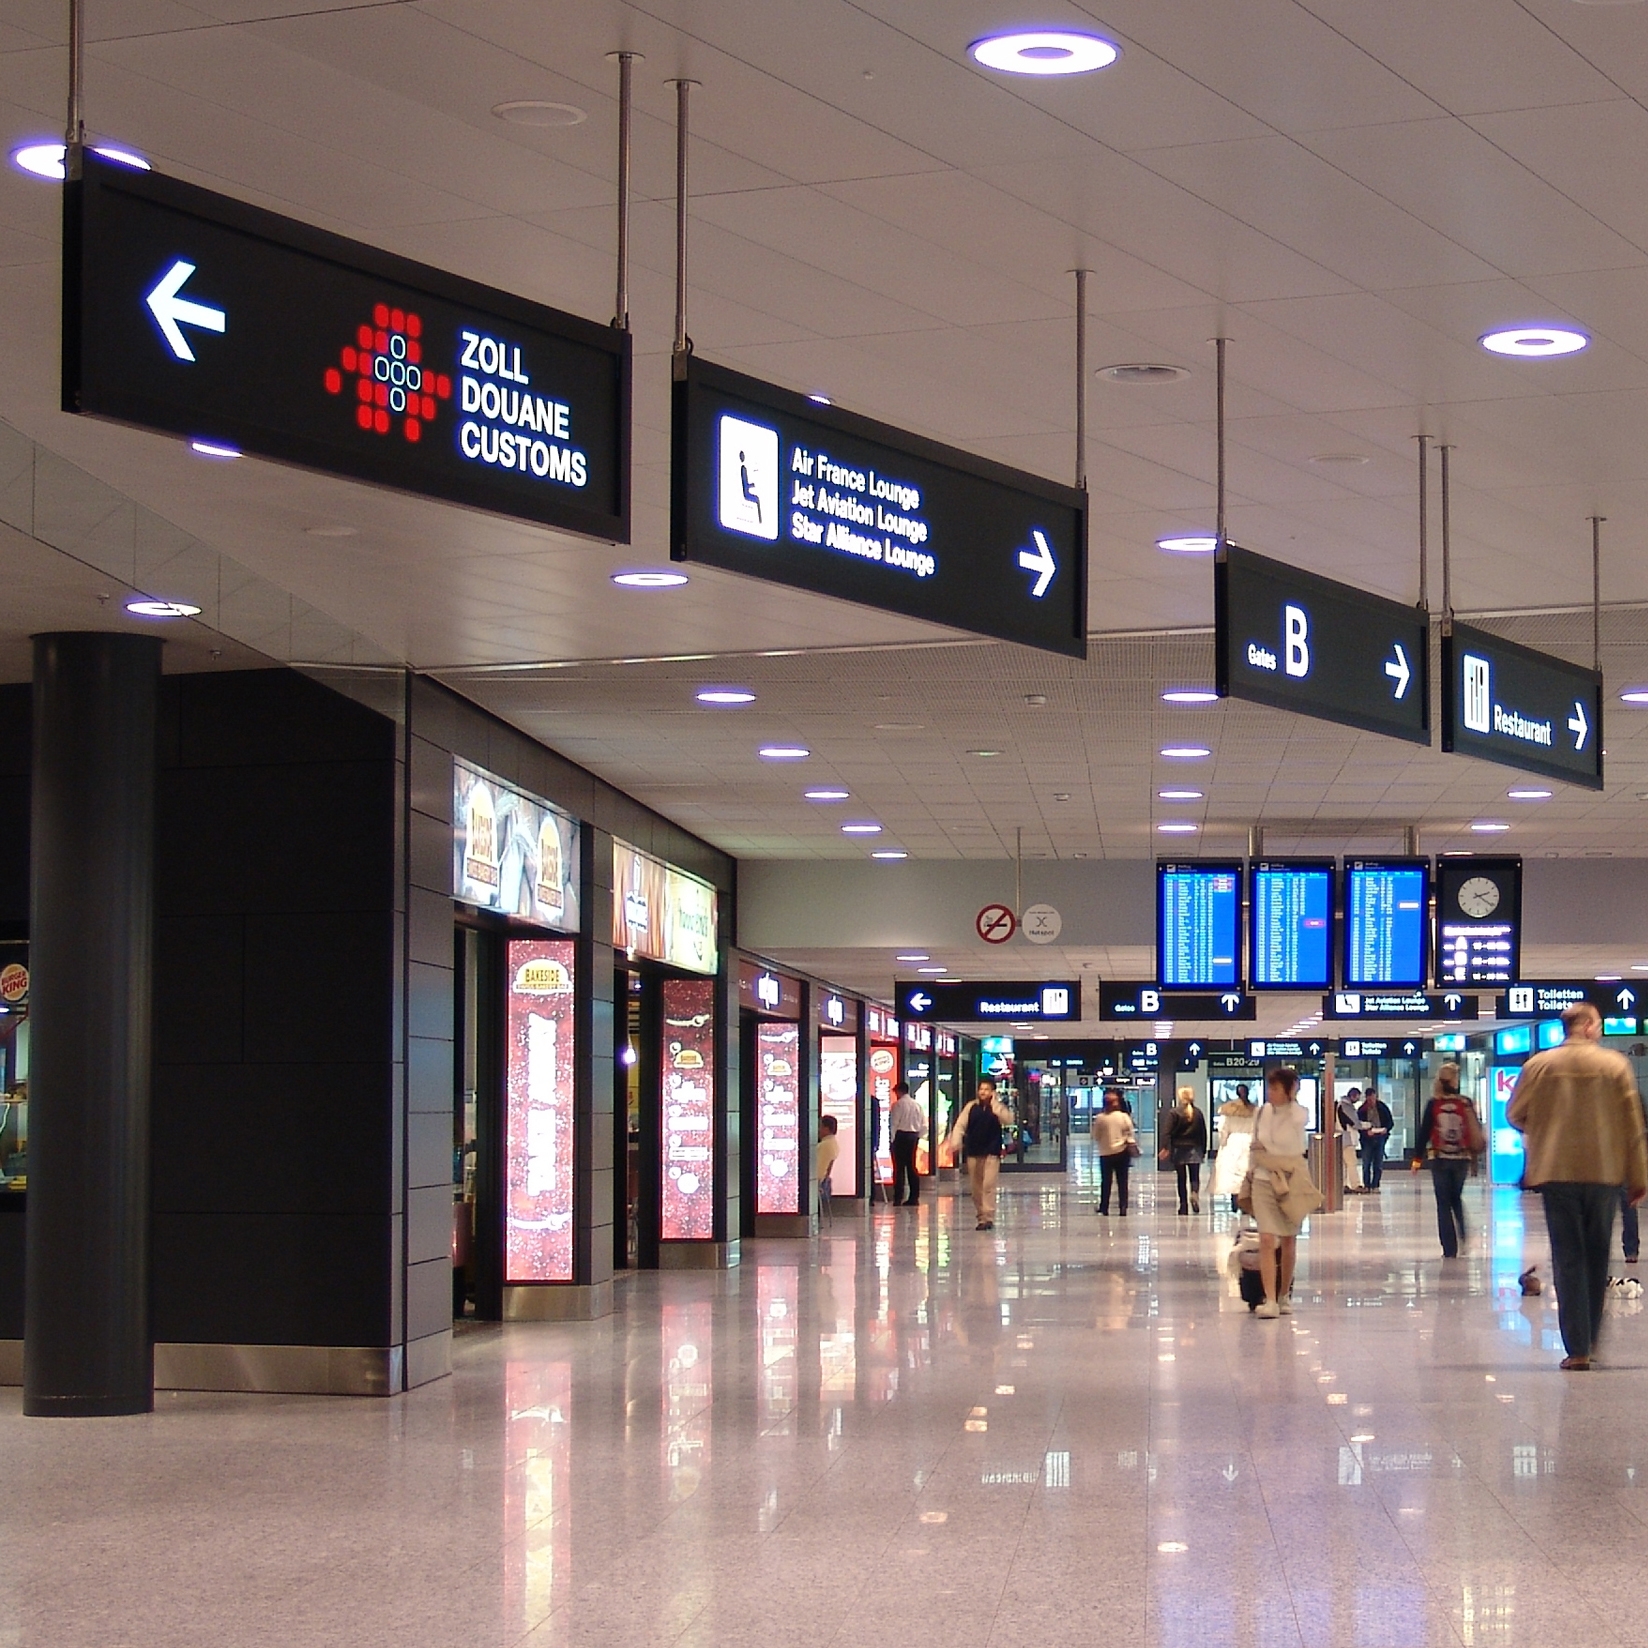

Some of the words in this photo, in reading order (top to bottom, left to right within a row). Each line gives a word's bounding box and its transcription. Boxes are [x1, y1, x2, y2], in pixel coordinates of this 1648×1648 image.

[461, 331, 529, 385] ZOLL
[462, 375, 570, 440] DOUANE
[461, 421, 587, 487] CUSTOMS
[792, 447, 814, 476] Air
[817, 454, 866, 493] France
[869, 470, 920, 511] Lounge
[792, 480, 815, 510] Jet
[817, 487, 874, 527] Aviation
[877, 504, 928, 545] Lounge
[792, 511, 824, 544] Star
[826, 522, 883, 561] Alliance
[885, 538, 935, 577] Lounge
[1247, 643, 1277, 671] Gates
[1285, 605, 1309, 678] B
[1494, 704, 1552, 746] Restaurant
[2, 978, 27, 994] KING
[525, 969, 560, 982] BAKESIDE
[1537, 989, 1584, 999] Toiletten
[980, 1001, 1040, 1013] Restaurant
[1141, 990, 1160, 1012] B
[1146, 1042, 1158, 1056] B
